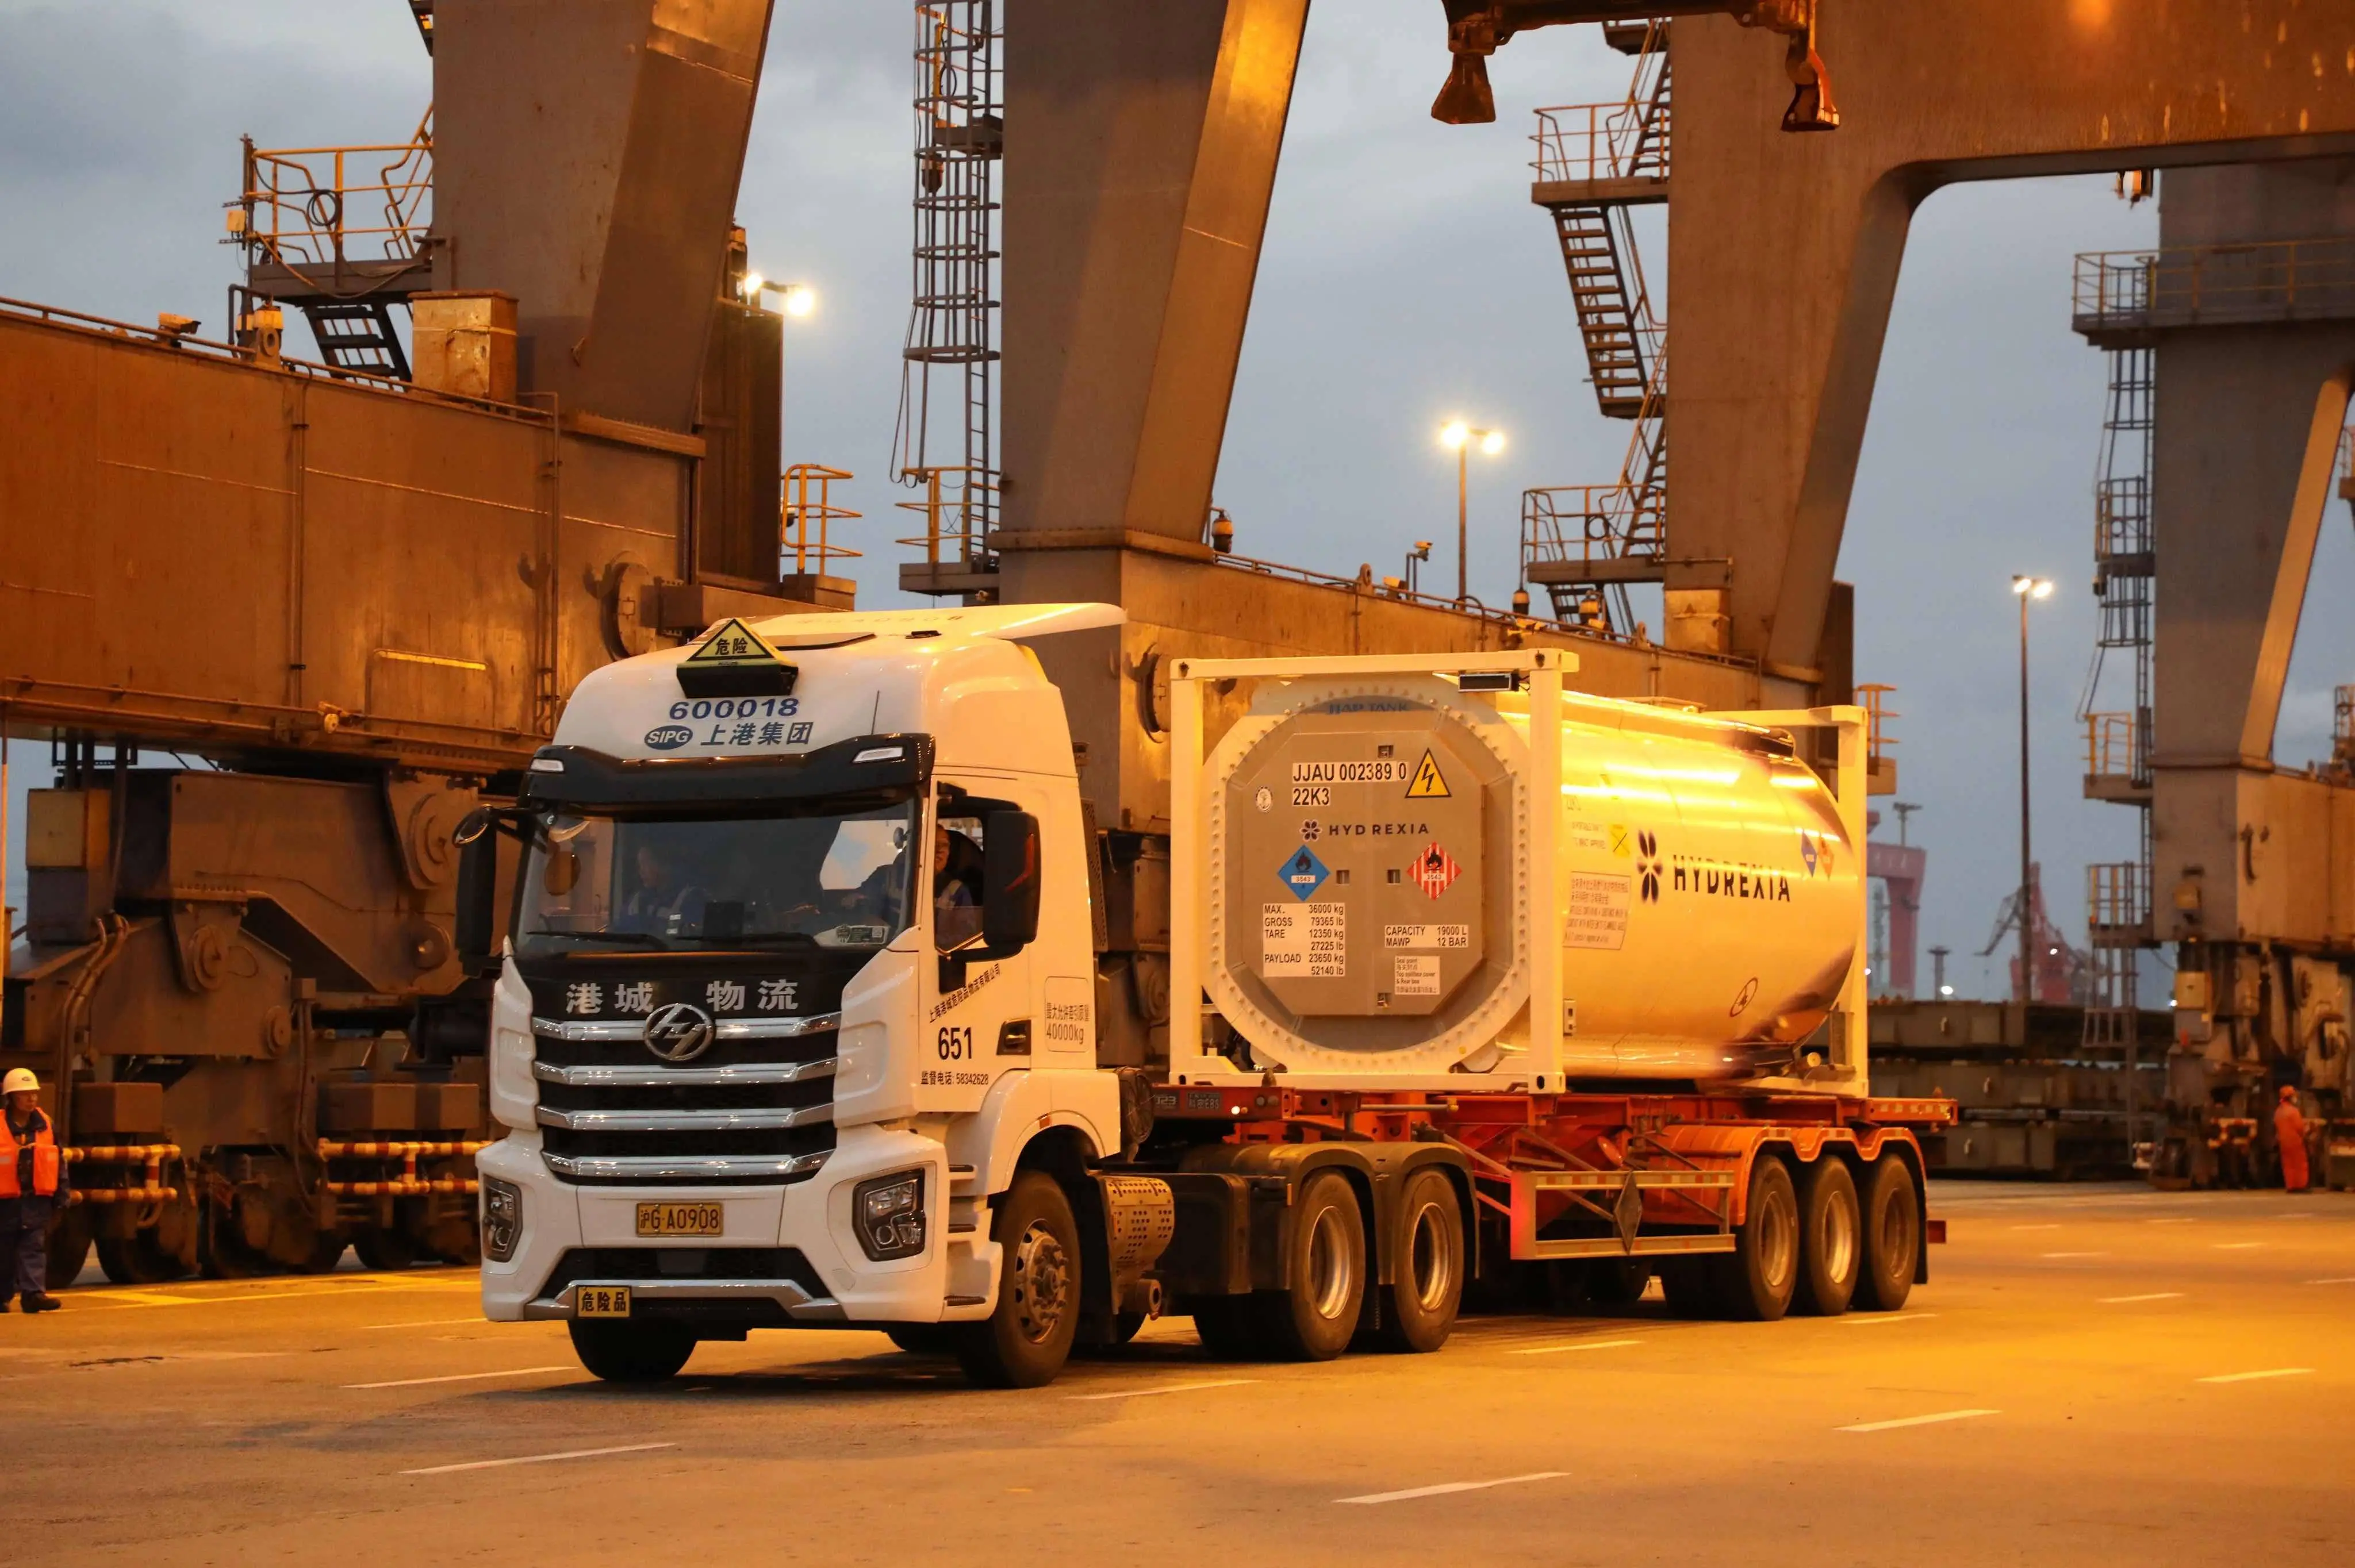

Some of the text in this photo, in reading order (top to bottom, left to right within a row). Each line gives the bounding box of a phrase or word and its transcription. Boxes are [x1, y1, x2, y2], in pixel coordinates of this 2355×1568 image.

[715, 637, 748, 655] 危险
[669, 698, 799, 720] 600018
[646, 721, 814, 746] SIPG 上港集团
[1293, 762, 1407, 782] JJAU 002389 0
[1293, 787, 1330, 805] 22K3
[1329, 823, 1429, 836] HYDREXIA
[1673, 854, 1790, 902] HYDREXIA
[1264, 904, 1344, 915] MAX. 36000 kg
[1264, 917, 1344, 927] GROSS 79365 lb
[1265, 928, 1344, 940] TARE 12350 kg
[1386, 926, 1467, 936] CAPACITY 19000 L
[1311, 941, 1344, 951] 27225 lb
[1386, 937, 1467, 947] MAWP 12 BAR
[1264, 953, 1344, 964] PAYLOAD 23650 kg
[1311, 966, 1344, 975] 52140 lb
[1046, 1023, 1084, 1045] 40000kg
[938, 1027, 972, 1060] 651
[581, 1292, 626, 1312] 危险品
